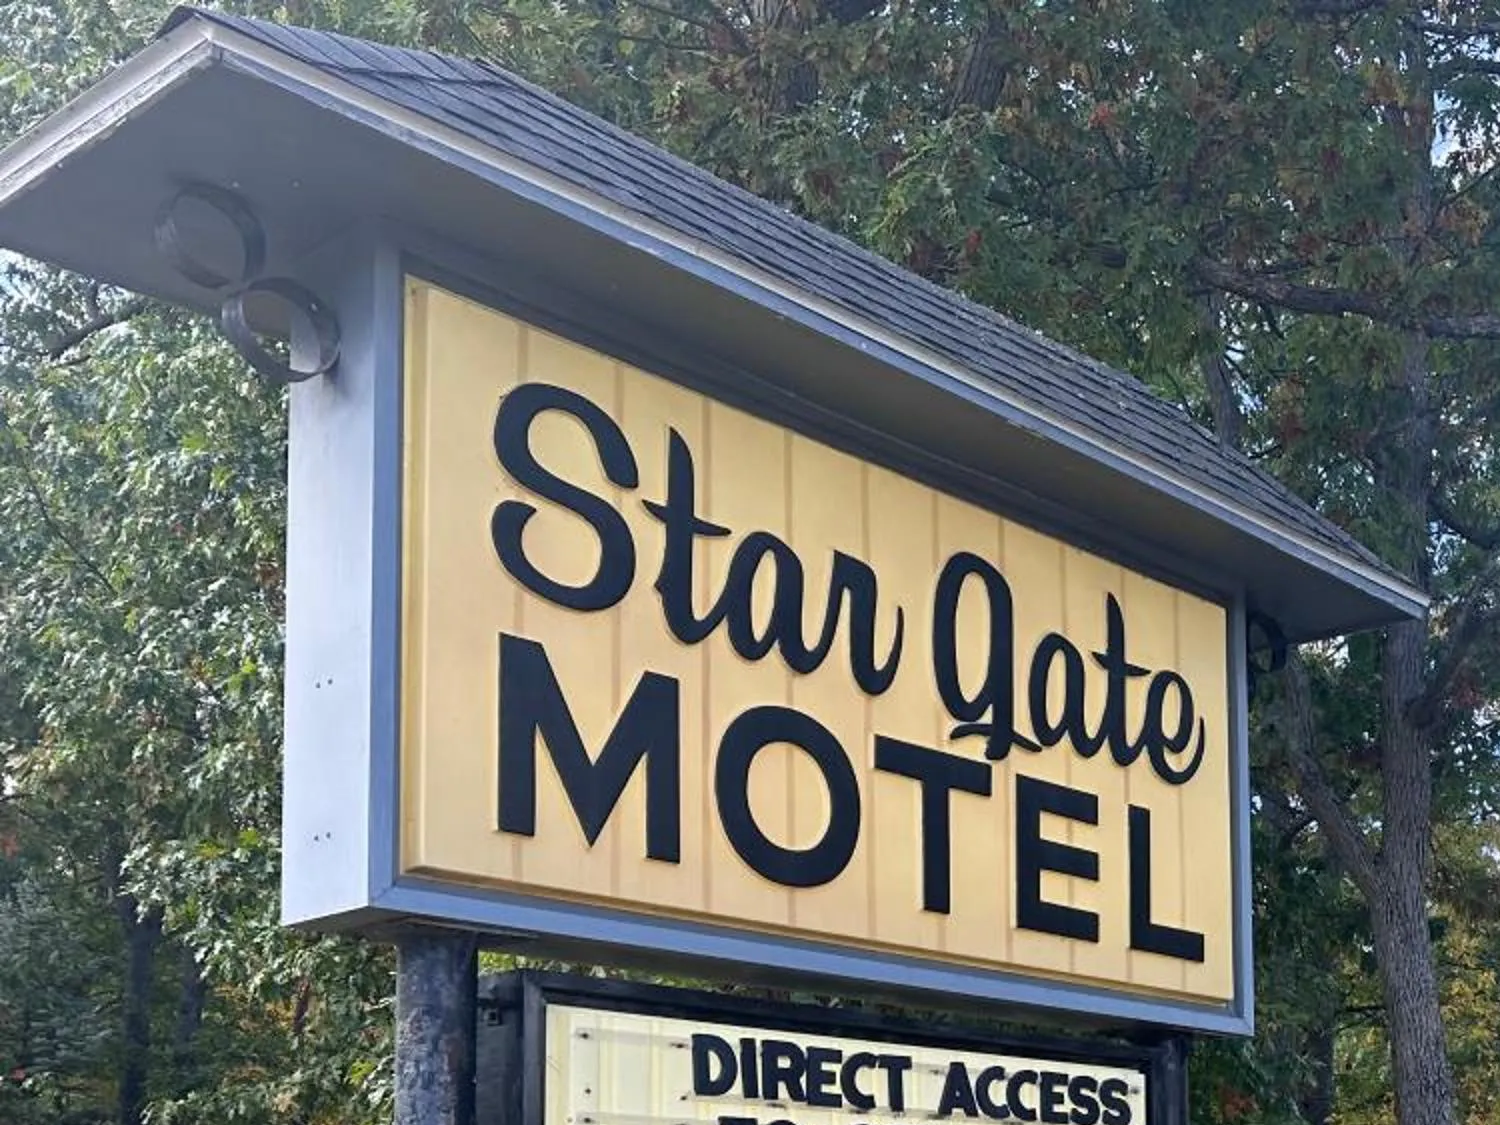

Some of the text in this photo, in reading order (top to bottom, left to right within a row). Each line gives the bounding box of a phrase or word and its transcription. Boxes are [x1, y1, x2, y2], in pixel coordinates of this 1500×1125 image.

[491, 382, 904, 696] Star
[496, 632, 1205, 963] MOTEL
[691, 1033, 912, 1112] DIRECT
